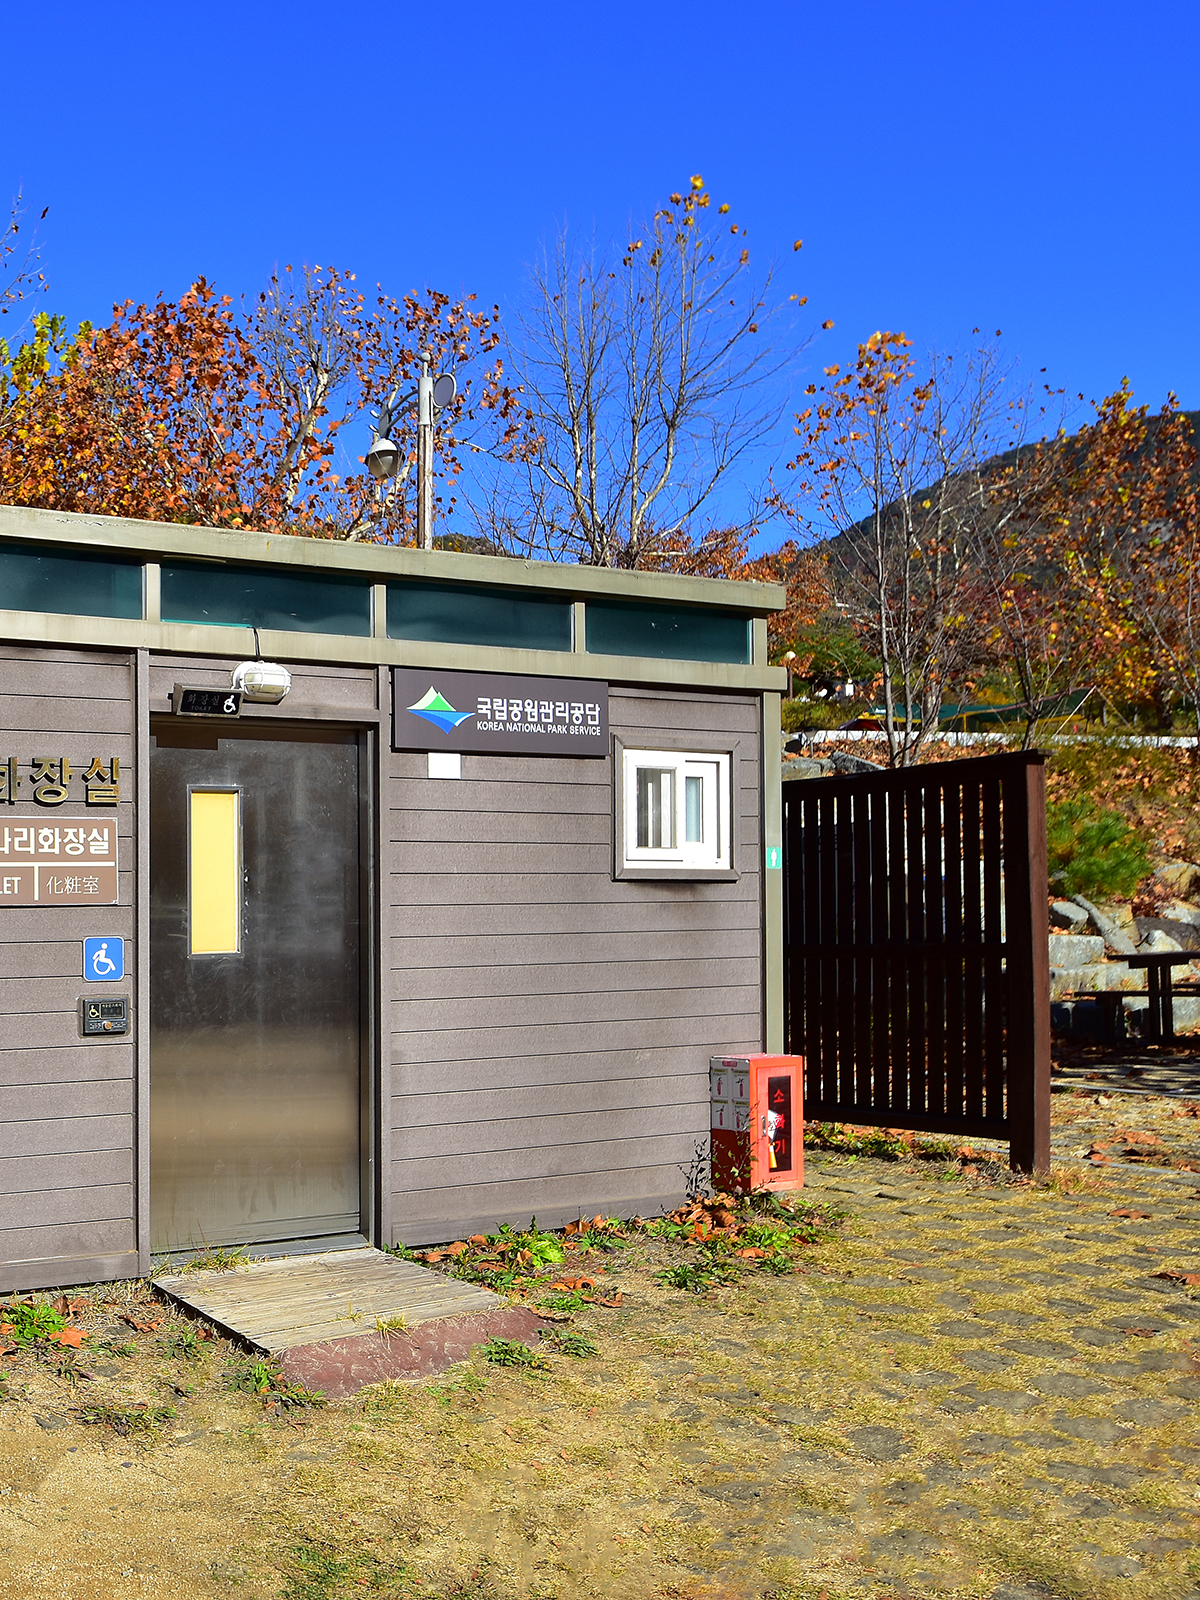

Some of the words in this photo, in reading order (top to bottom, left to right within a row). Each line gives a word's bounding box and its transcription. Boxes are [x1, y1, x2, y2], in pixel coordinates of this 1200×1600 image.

[477, 697, 601, 726] 국립공원관리공단
[477, 720, 504, 732] KOREA
[506, 722, 546, 734] NATIONAL
[547, 724, 567, 735] PARK
[569, 725, 601, 736] SERVICE
[46, 875, 100, 896] 化粧室
